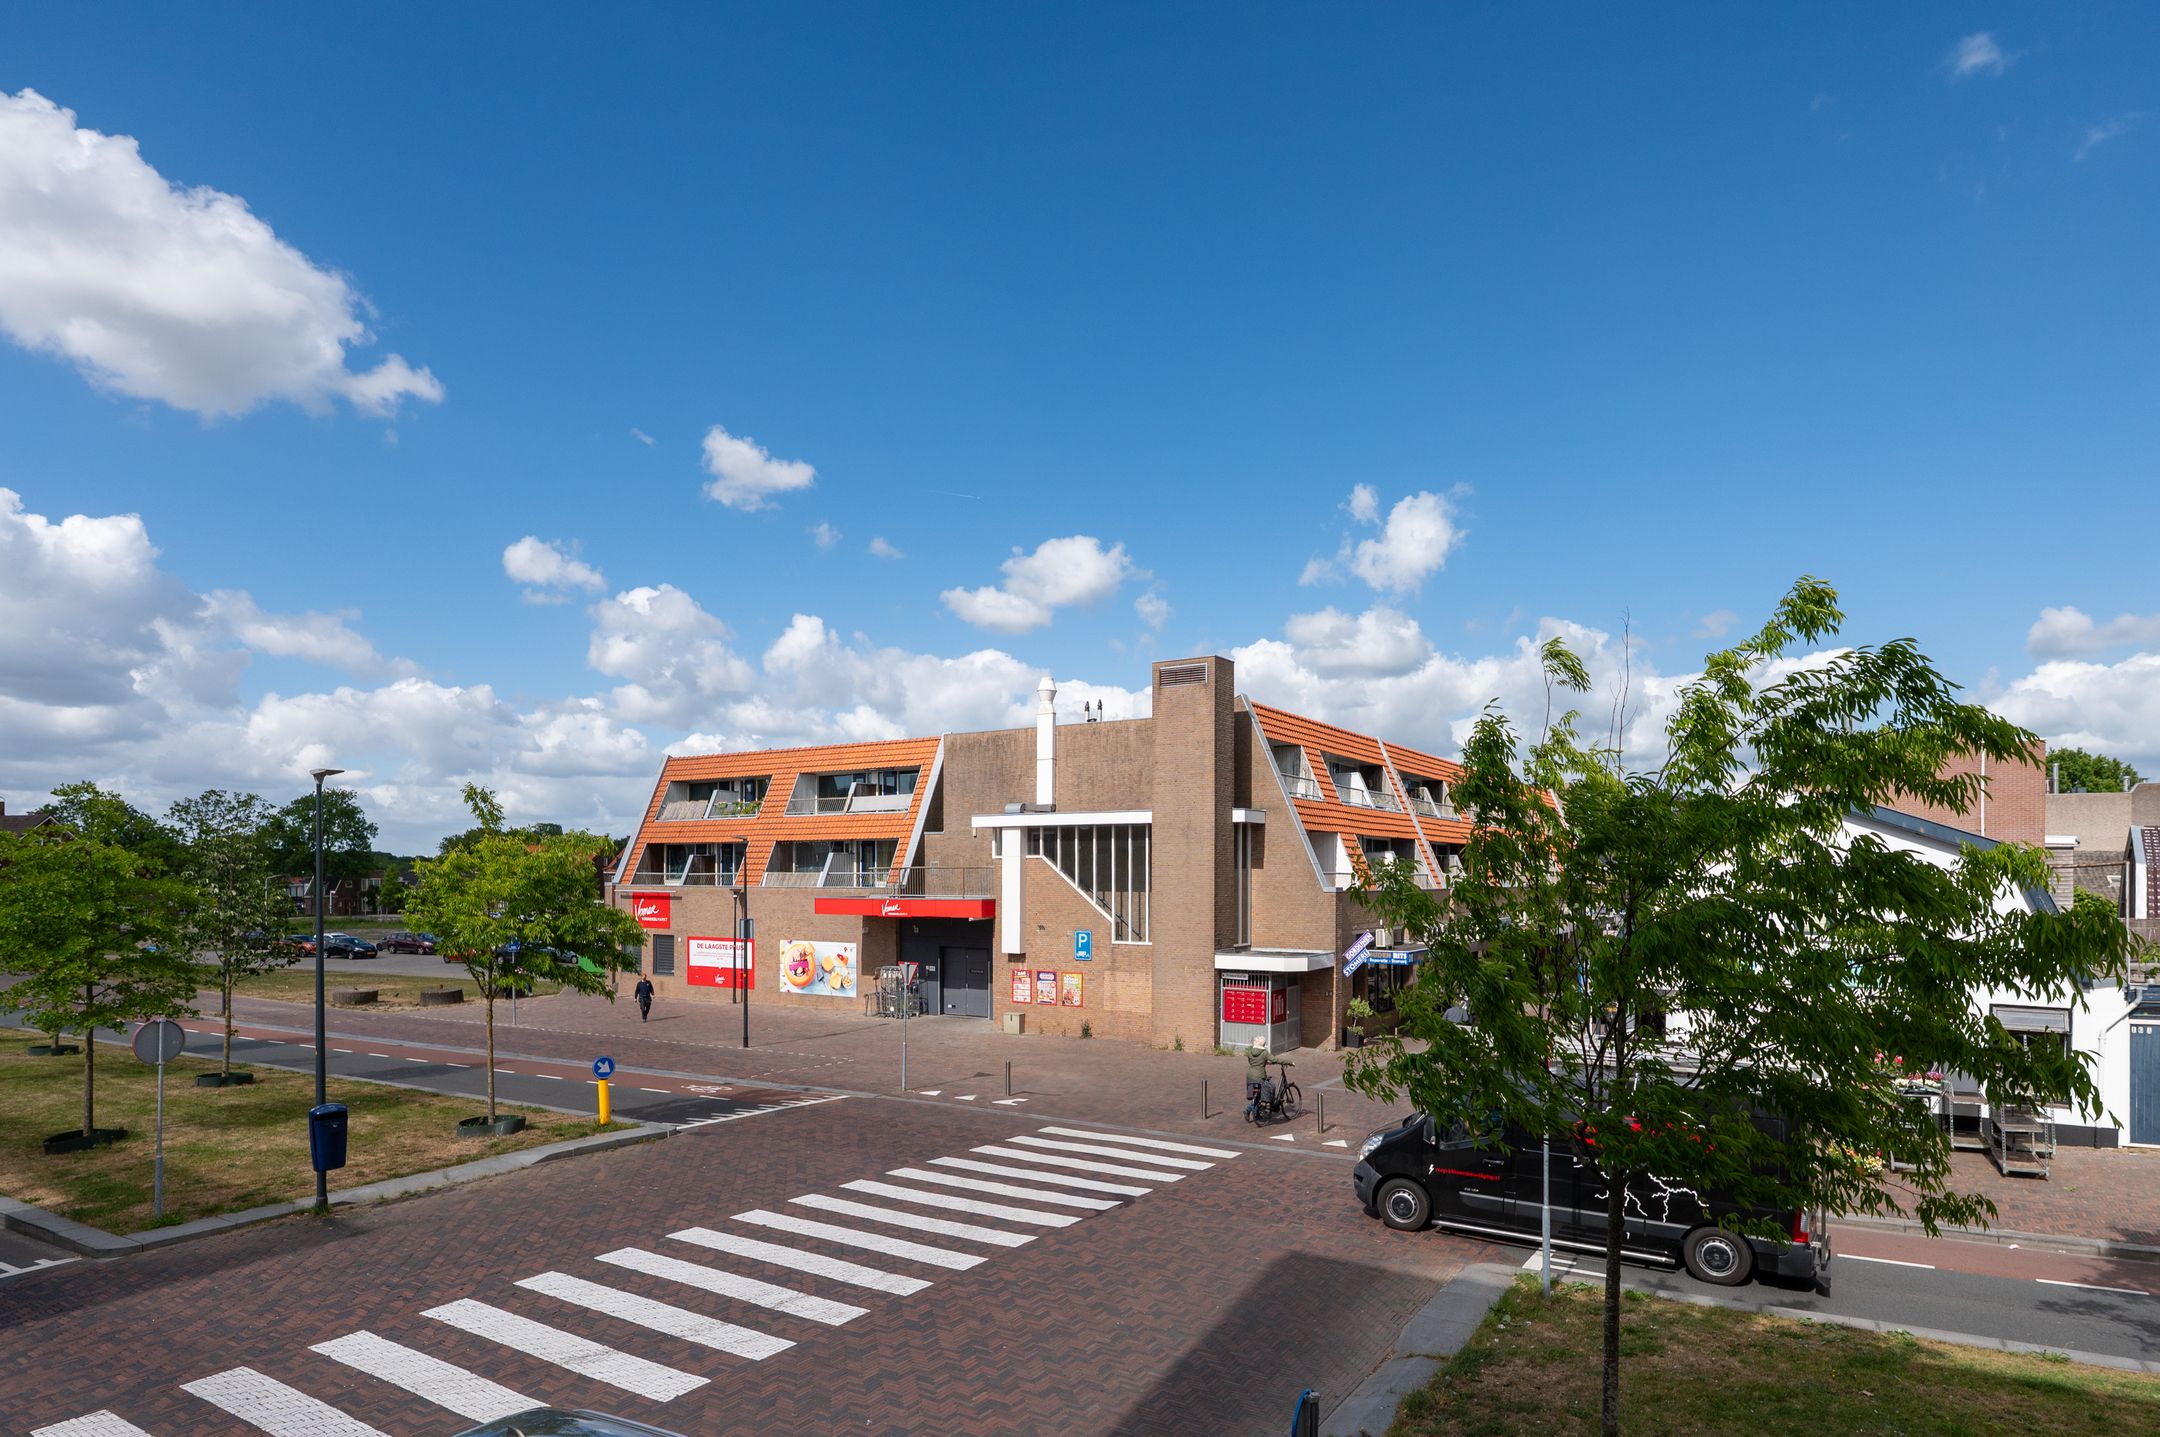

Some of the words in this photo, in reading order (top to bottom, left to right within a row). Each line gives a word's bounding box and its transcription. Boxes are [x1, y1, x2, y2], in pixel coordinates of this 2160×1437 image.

[634, 898, 660, 922] Vomar
[881, 899, 902, 917] Vomar
[1078, 933, 1088, 948] P
[1346, 932, 1374, 960] GORDIJNEN
[1343, 948, 1370, 977] STOMERIJ
